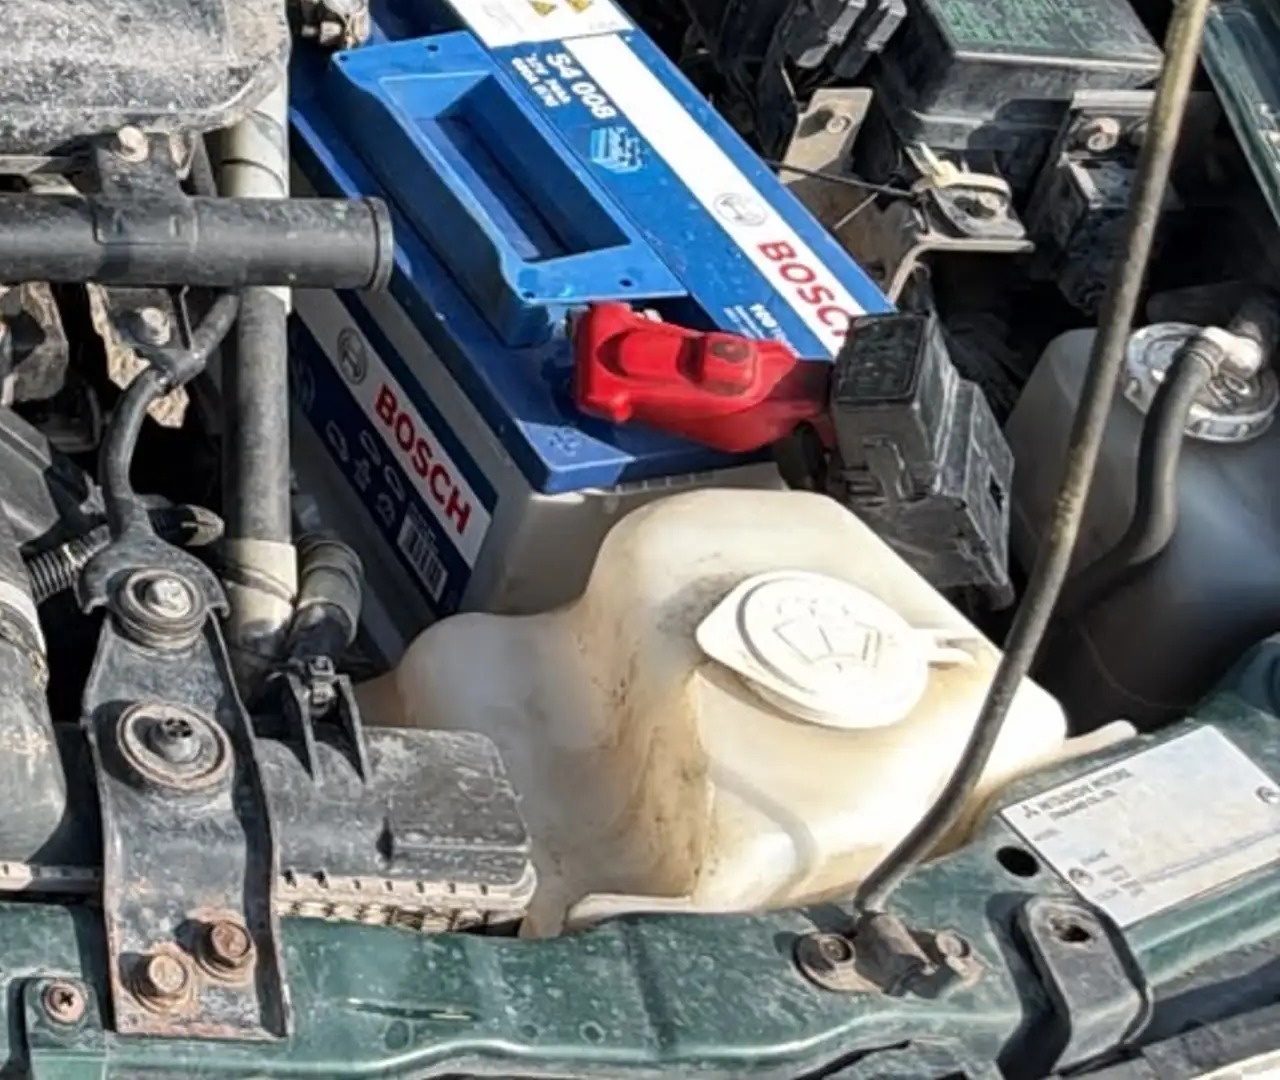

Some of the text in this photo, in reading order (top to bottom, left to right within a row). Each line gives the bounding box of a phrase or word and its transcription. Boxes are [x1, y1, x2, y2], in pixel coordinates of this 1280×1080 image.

[545, 52, 617, 119] S4 008
[757, 241, 849, 337] BOSC
[375, 395, 472, 535] BOSCH
